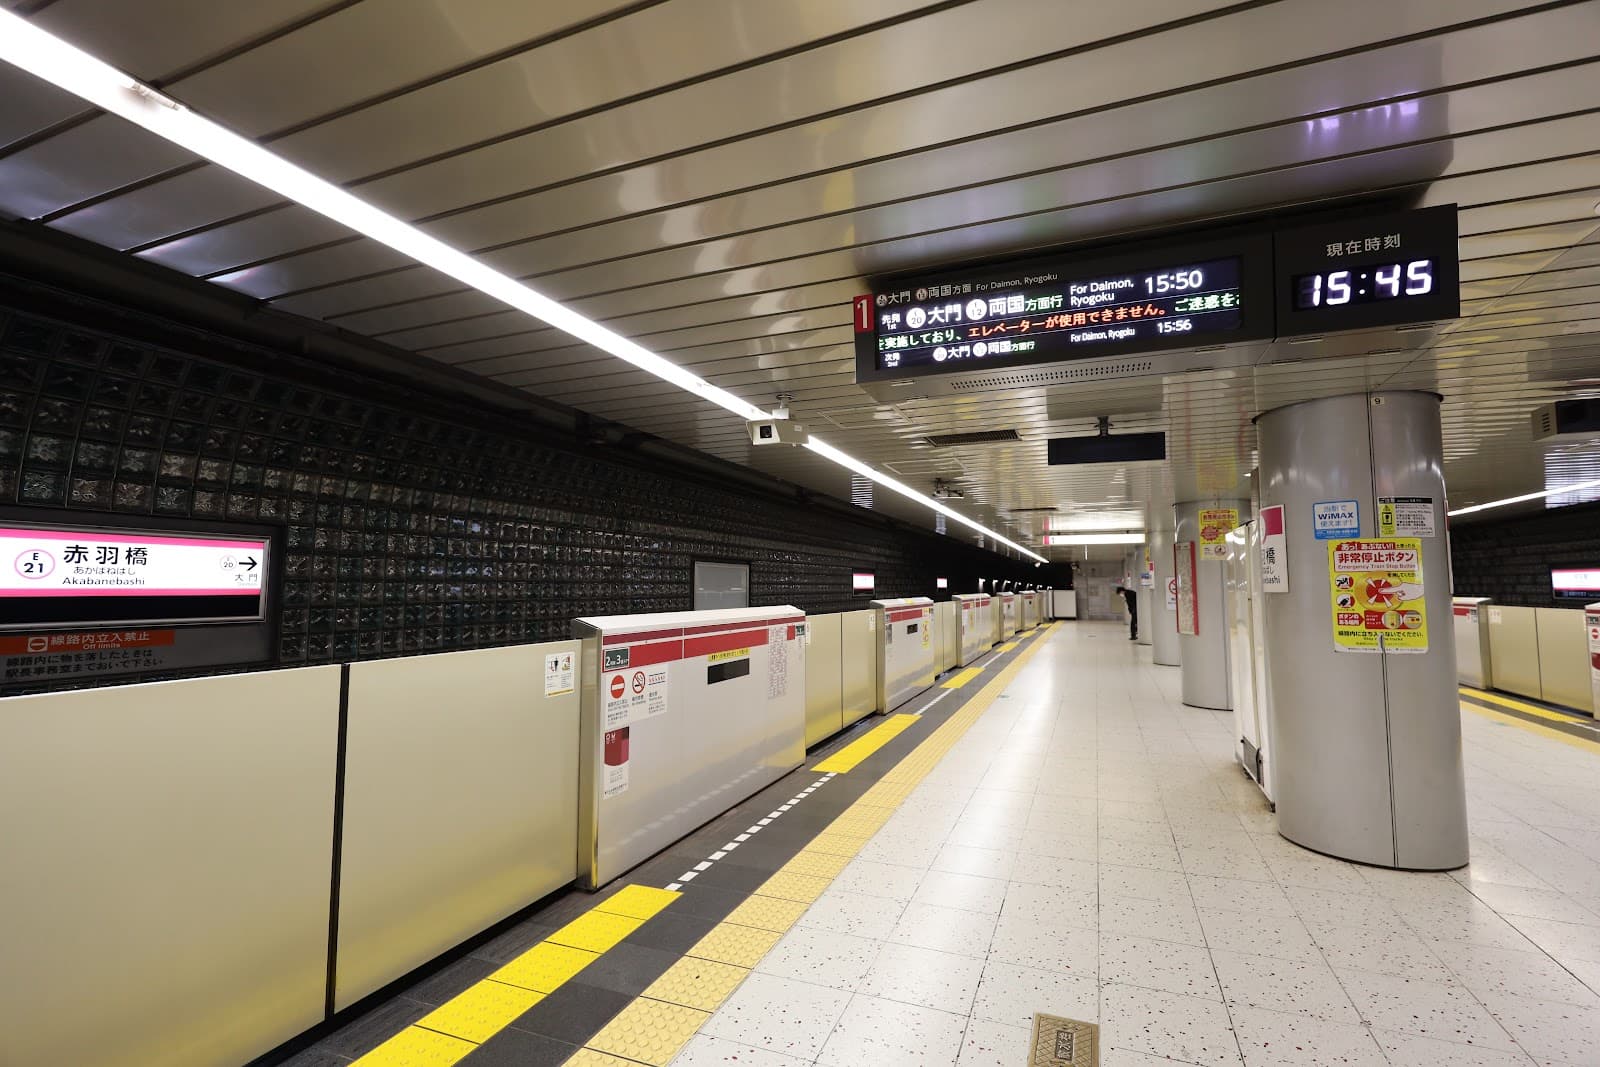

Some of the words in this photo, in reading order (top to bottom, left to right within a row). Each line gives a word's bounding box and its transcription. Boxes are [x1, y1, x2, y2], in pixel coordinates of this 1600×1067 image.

[1326, 233, 1400, 257] 現在時刻
[888, 290, 911, 304] 大門
[928, 283, 972, 299] 両国方面
[976, 283, 989, 292] For
[991, 278, 1022, 290] Daimon,
[1024, 271, 1058, 286] Ryogoku
[1070, 284, 1088, 295] For
[1090, 278, 1134, 292] Daimon,
[1145, 270, 1203, 294] 15:50
[1313, 260, 1432, 306] 15:45
[1070, 291, 1115, 307] Ryogoku
[1175, 293, 1239, 312] ご迷惑を
[857, 299, 868, 329] 1
[928, 304, 961, 325] 大門
[988, 294, 1063, 316] 両国方面行
[1157, 319, 1192, 334] 15:56
[1071, 333, 1081, 343] For
[1082, 330, 1107, 342] Daimon,
[1108, 328, 1135, 339] Ryogoku
[948, 345, 970, 358] 大門
[1318, 512, 1354, 520] WiMAX
[33, 552, 39, 561] E
[63, 544, 148, 566] 赤羽橋
[1338, 552, 1414, 564] 非常停止ボタン
[23, 562, 44, 574] 21
[62, 575, 145, 586] Akabanebashi
[234, 573, 258, 582] 大門
[50, 632, 150, 646] 線路内立入禁止
[98, 642, 121, 650] limits
